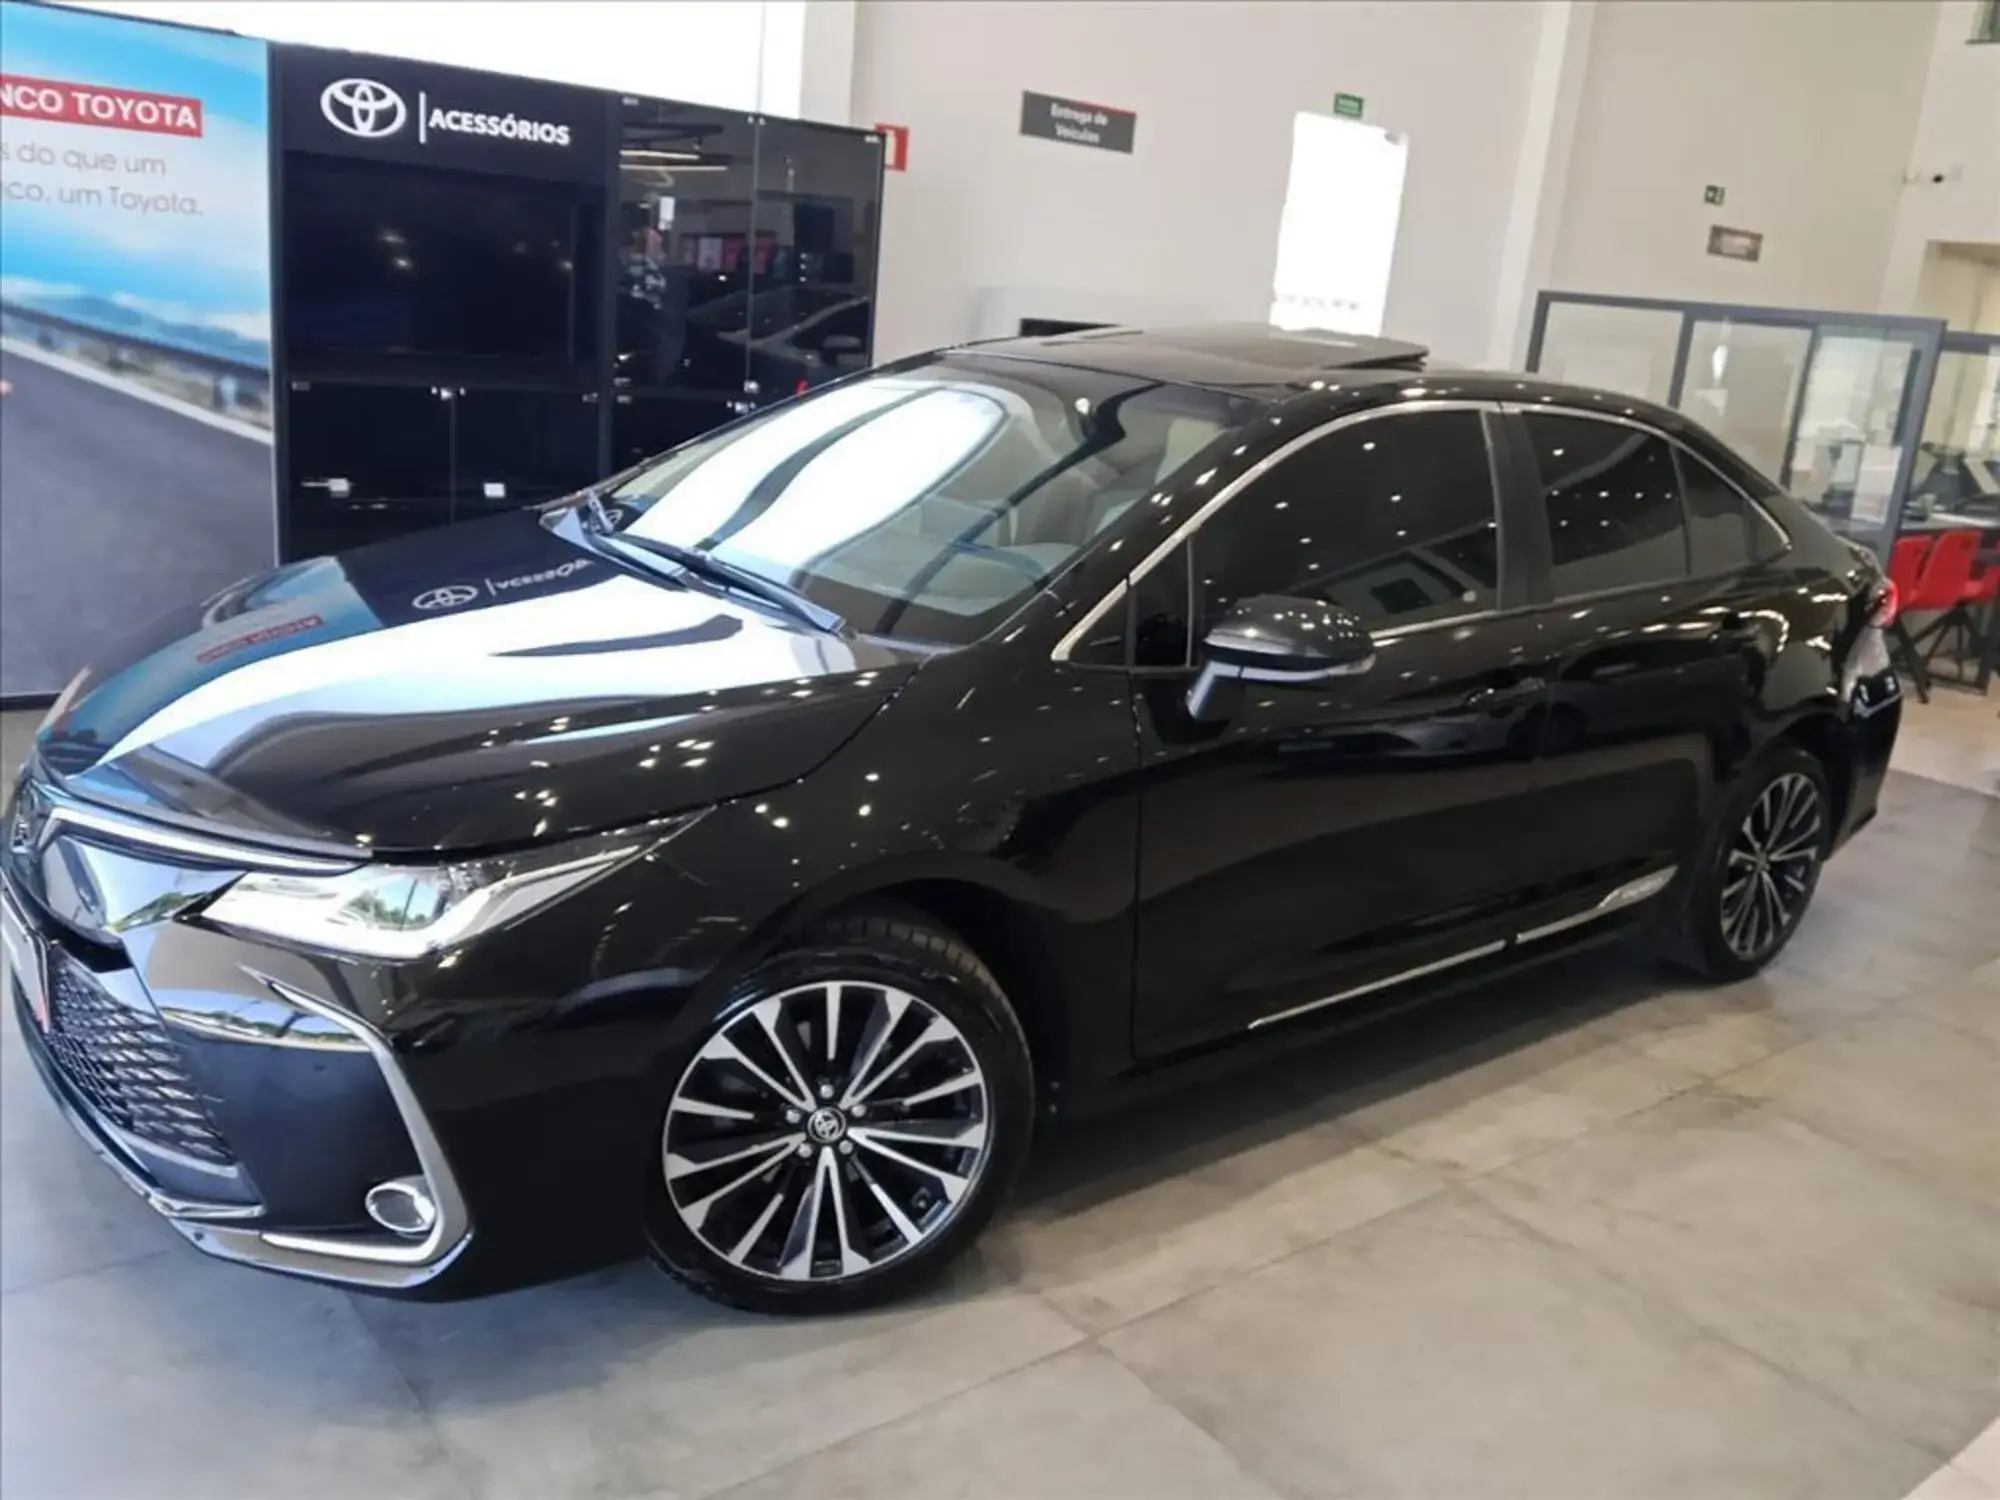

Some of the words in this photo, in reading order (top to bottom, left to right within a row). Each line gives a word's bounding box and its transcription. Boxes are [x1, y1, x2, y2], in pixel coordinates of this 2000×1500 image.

[71, 91, 199, 129] TOYOTA
[428, 107, 571, 146] ACESSÓRIOS
[17, 141, 56, 166] do
[62, 148, 118, 174] que
[123, 156, 166, 177] um
[59, 186, 102, 208] um
